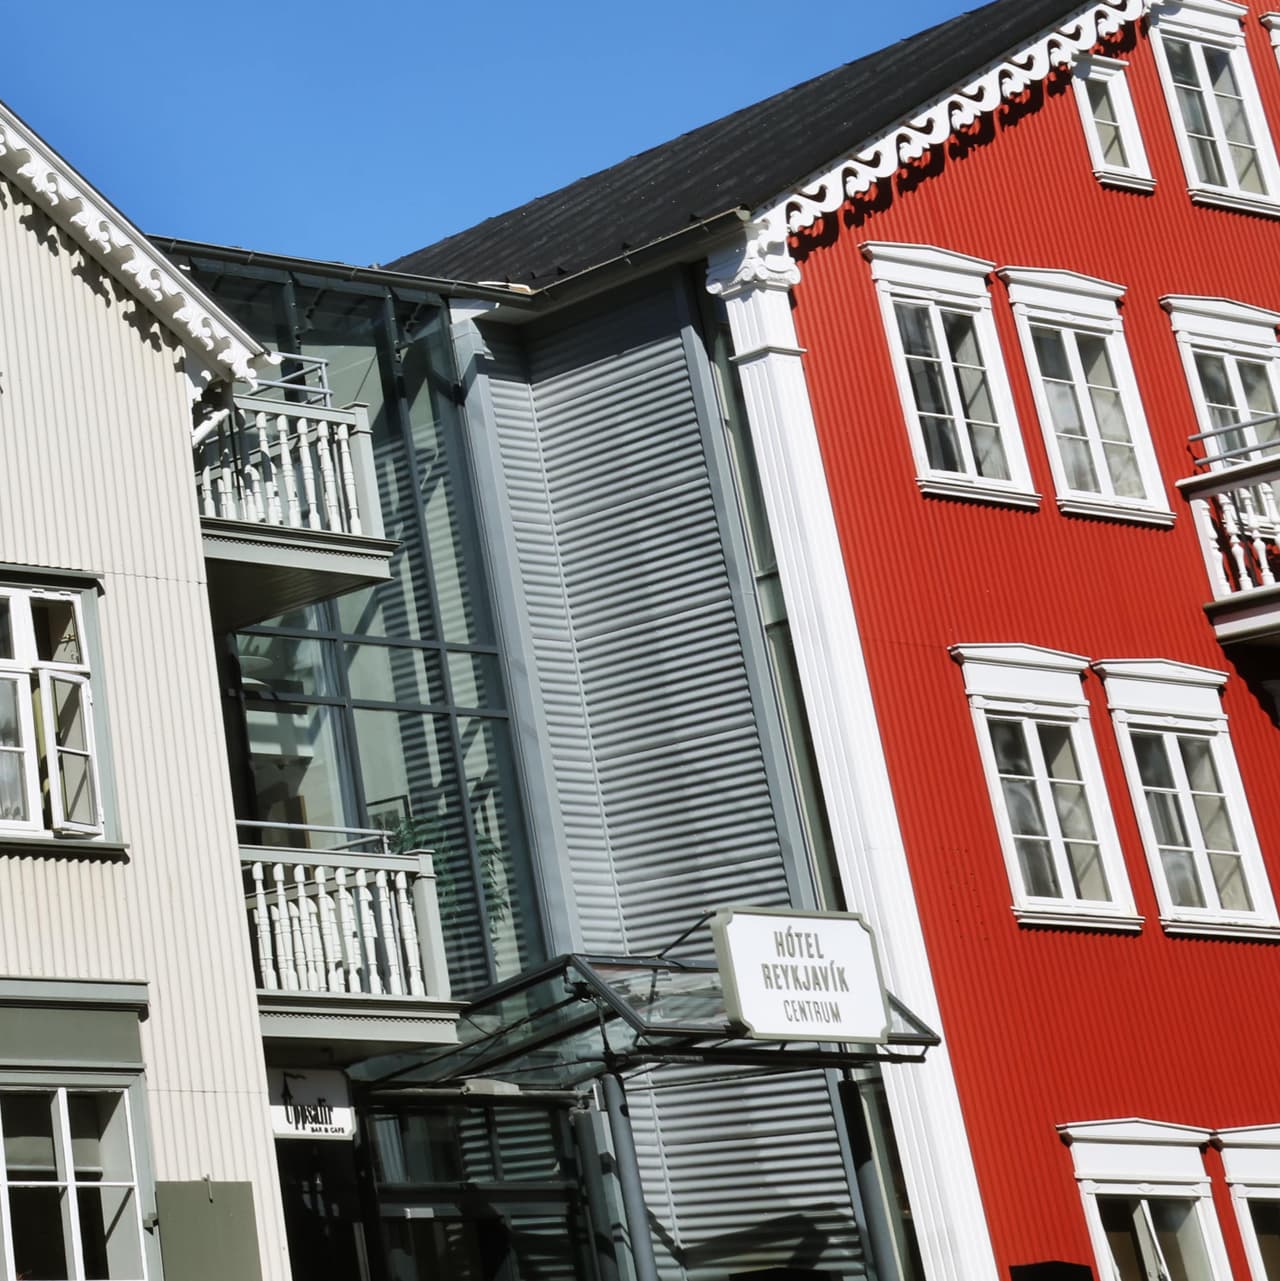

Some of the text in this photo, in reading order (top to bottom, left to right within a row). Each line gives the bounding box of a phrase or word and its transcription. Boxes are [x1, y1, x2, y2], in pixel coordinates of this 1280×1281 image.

[773, 925, 825, 959] HÓTEL
[761, 960, 850, 993] REYKJAVÍK
[783, 999, 842, 1024] CENTRUM
